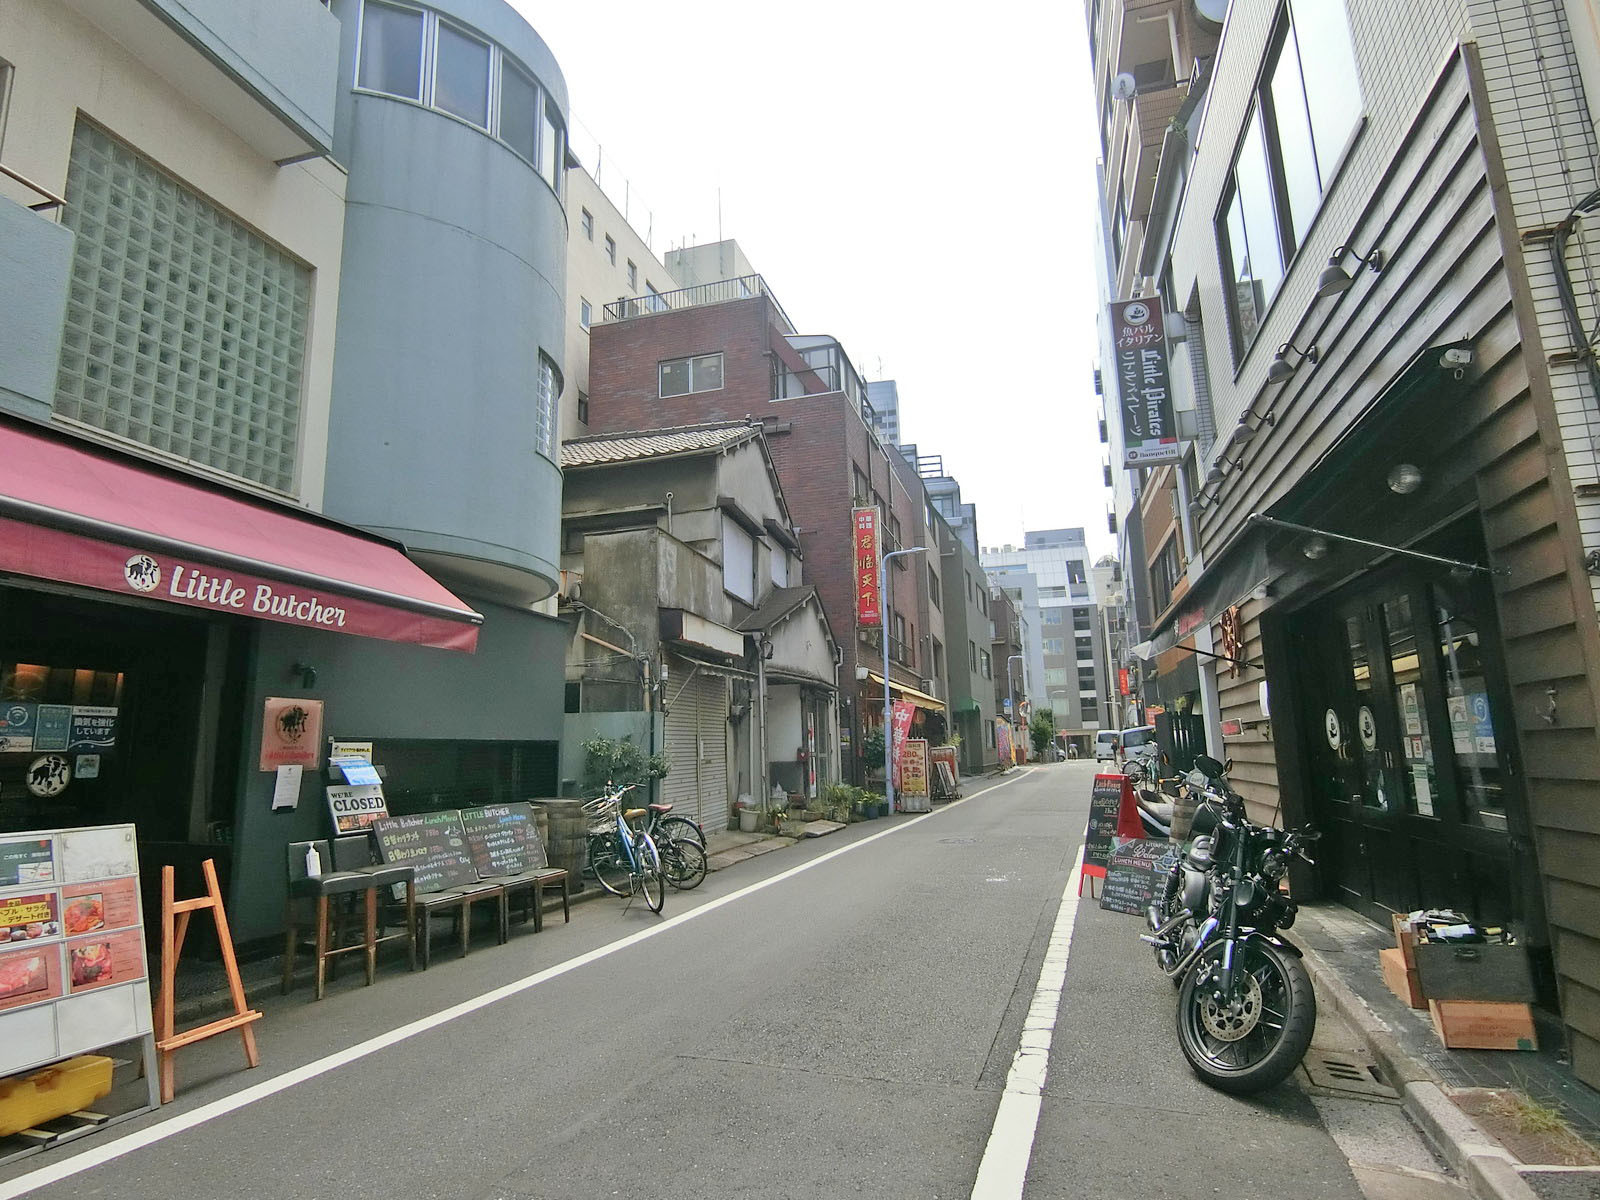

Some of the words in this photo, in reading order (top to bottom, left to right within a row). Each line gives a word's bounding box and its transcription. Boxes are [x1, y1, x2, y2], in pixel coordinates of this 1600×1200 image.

[1122, 324, 1155, 337] 魚バル
[1116, 333, 1164, 348] イタリアン
[1140, 349, 1163, 384] Little
[1121, 352, 1143, 437] リトルパイレーツ
[1141, 387, 1166, 436] Pirates
[169, 565, 246, 608] Little
[252, 584, 346, 627] Butcher
[76, 727, 111, 736] しています
[333, 797, 385, 812] CLOSED
[462, 810, 484, 821] LITTLE
[483, 807, 510, 818] BUTCHER
[378, 820, 399, 832] Little
[1113, 857, 1133, 866] LUNCH
[1133, 859, 1151, 868] MENU
